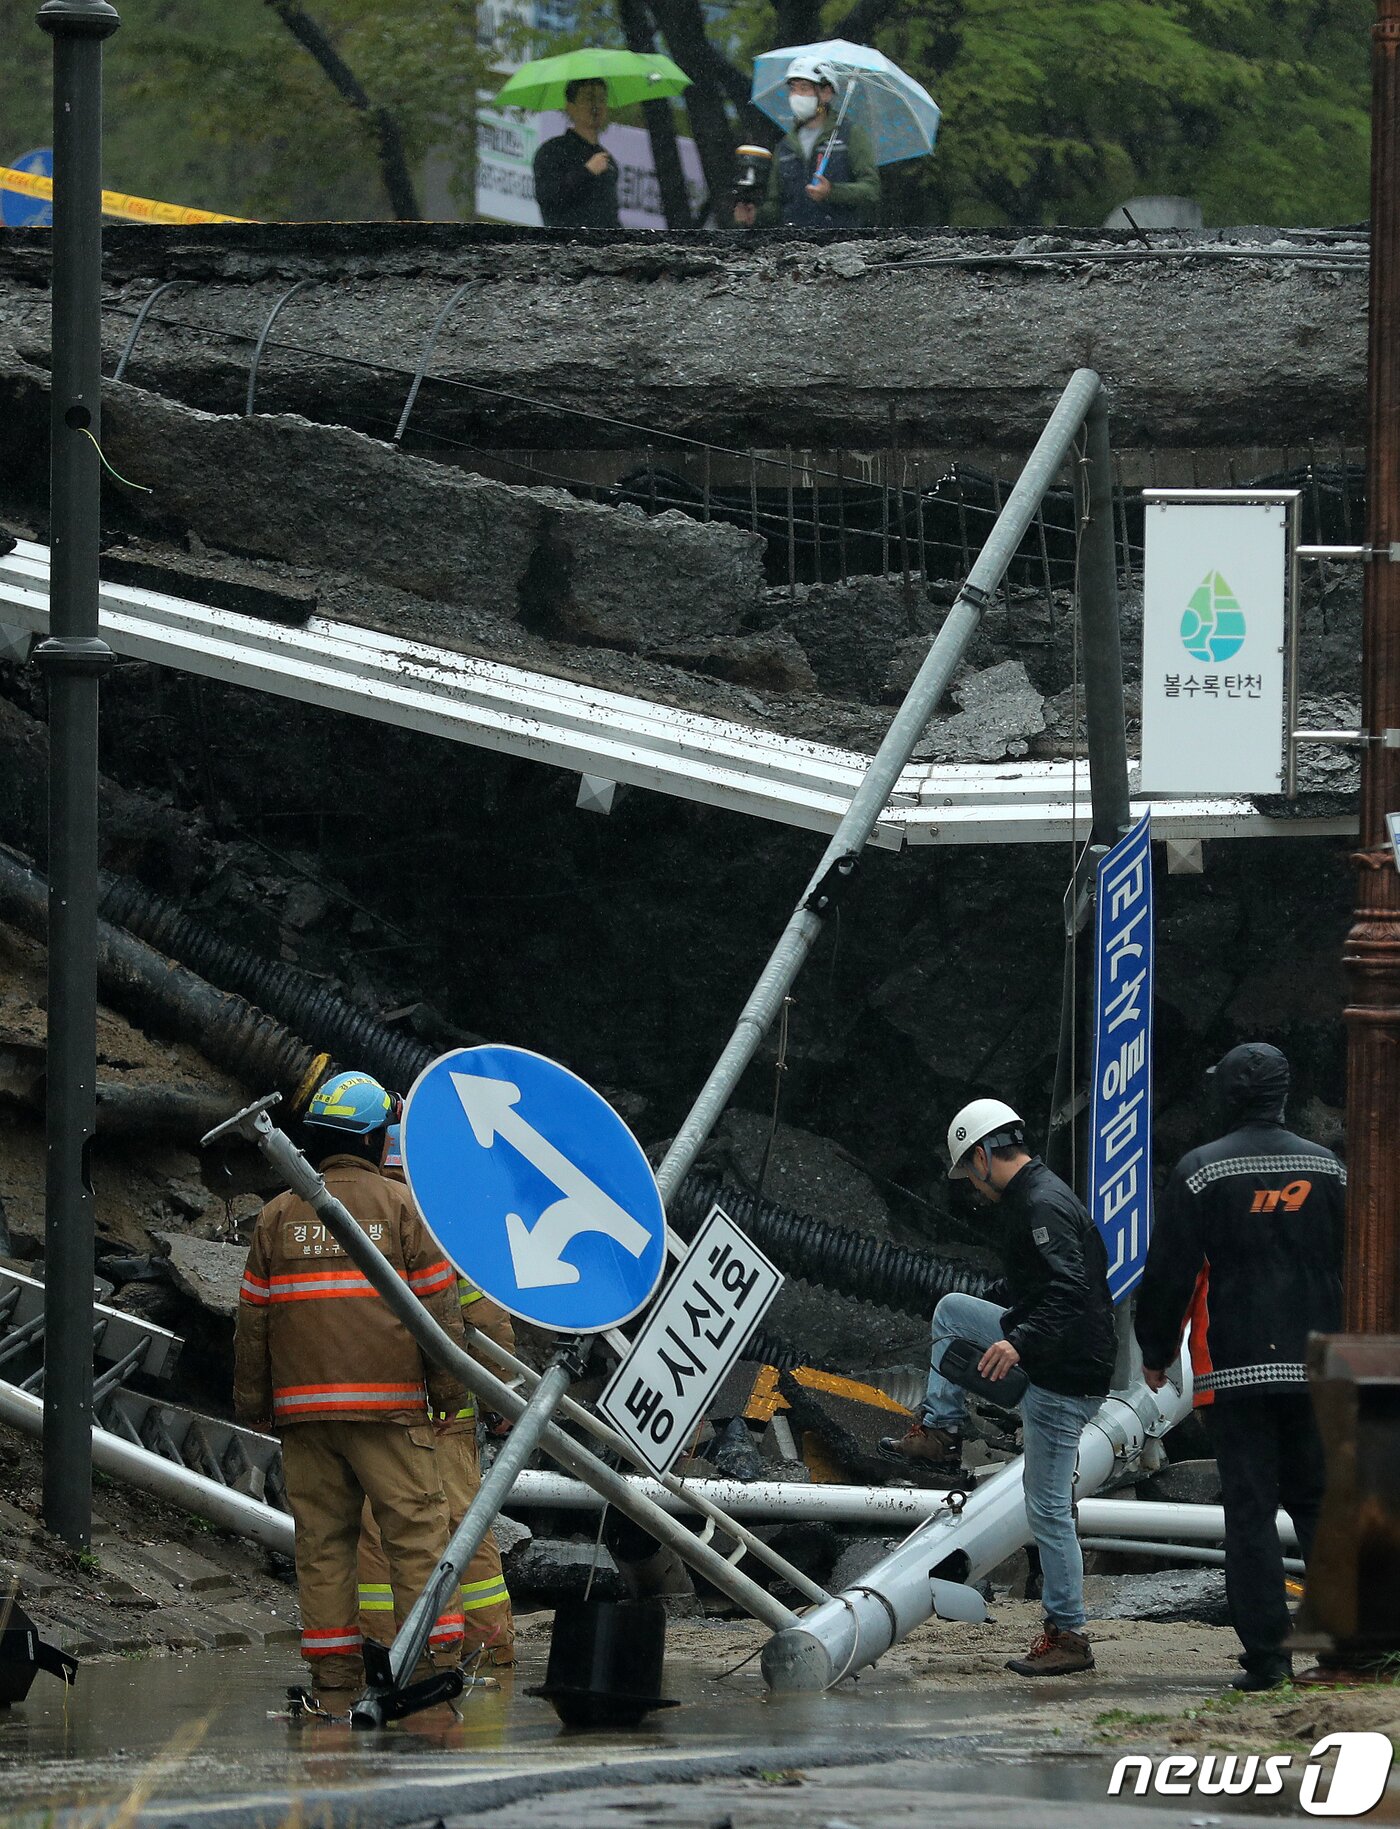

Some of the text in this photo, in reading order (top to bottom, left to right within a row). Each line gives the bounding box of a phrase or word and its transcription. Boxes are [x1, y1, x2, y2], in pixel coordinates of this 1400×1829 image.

[1164, 673, 1262, 698] 볼수록 탄천
[1249, 1180, 1313, 1213] 119
[624, 1243, 760, 1444] 동시신호
